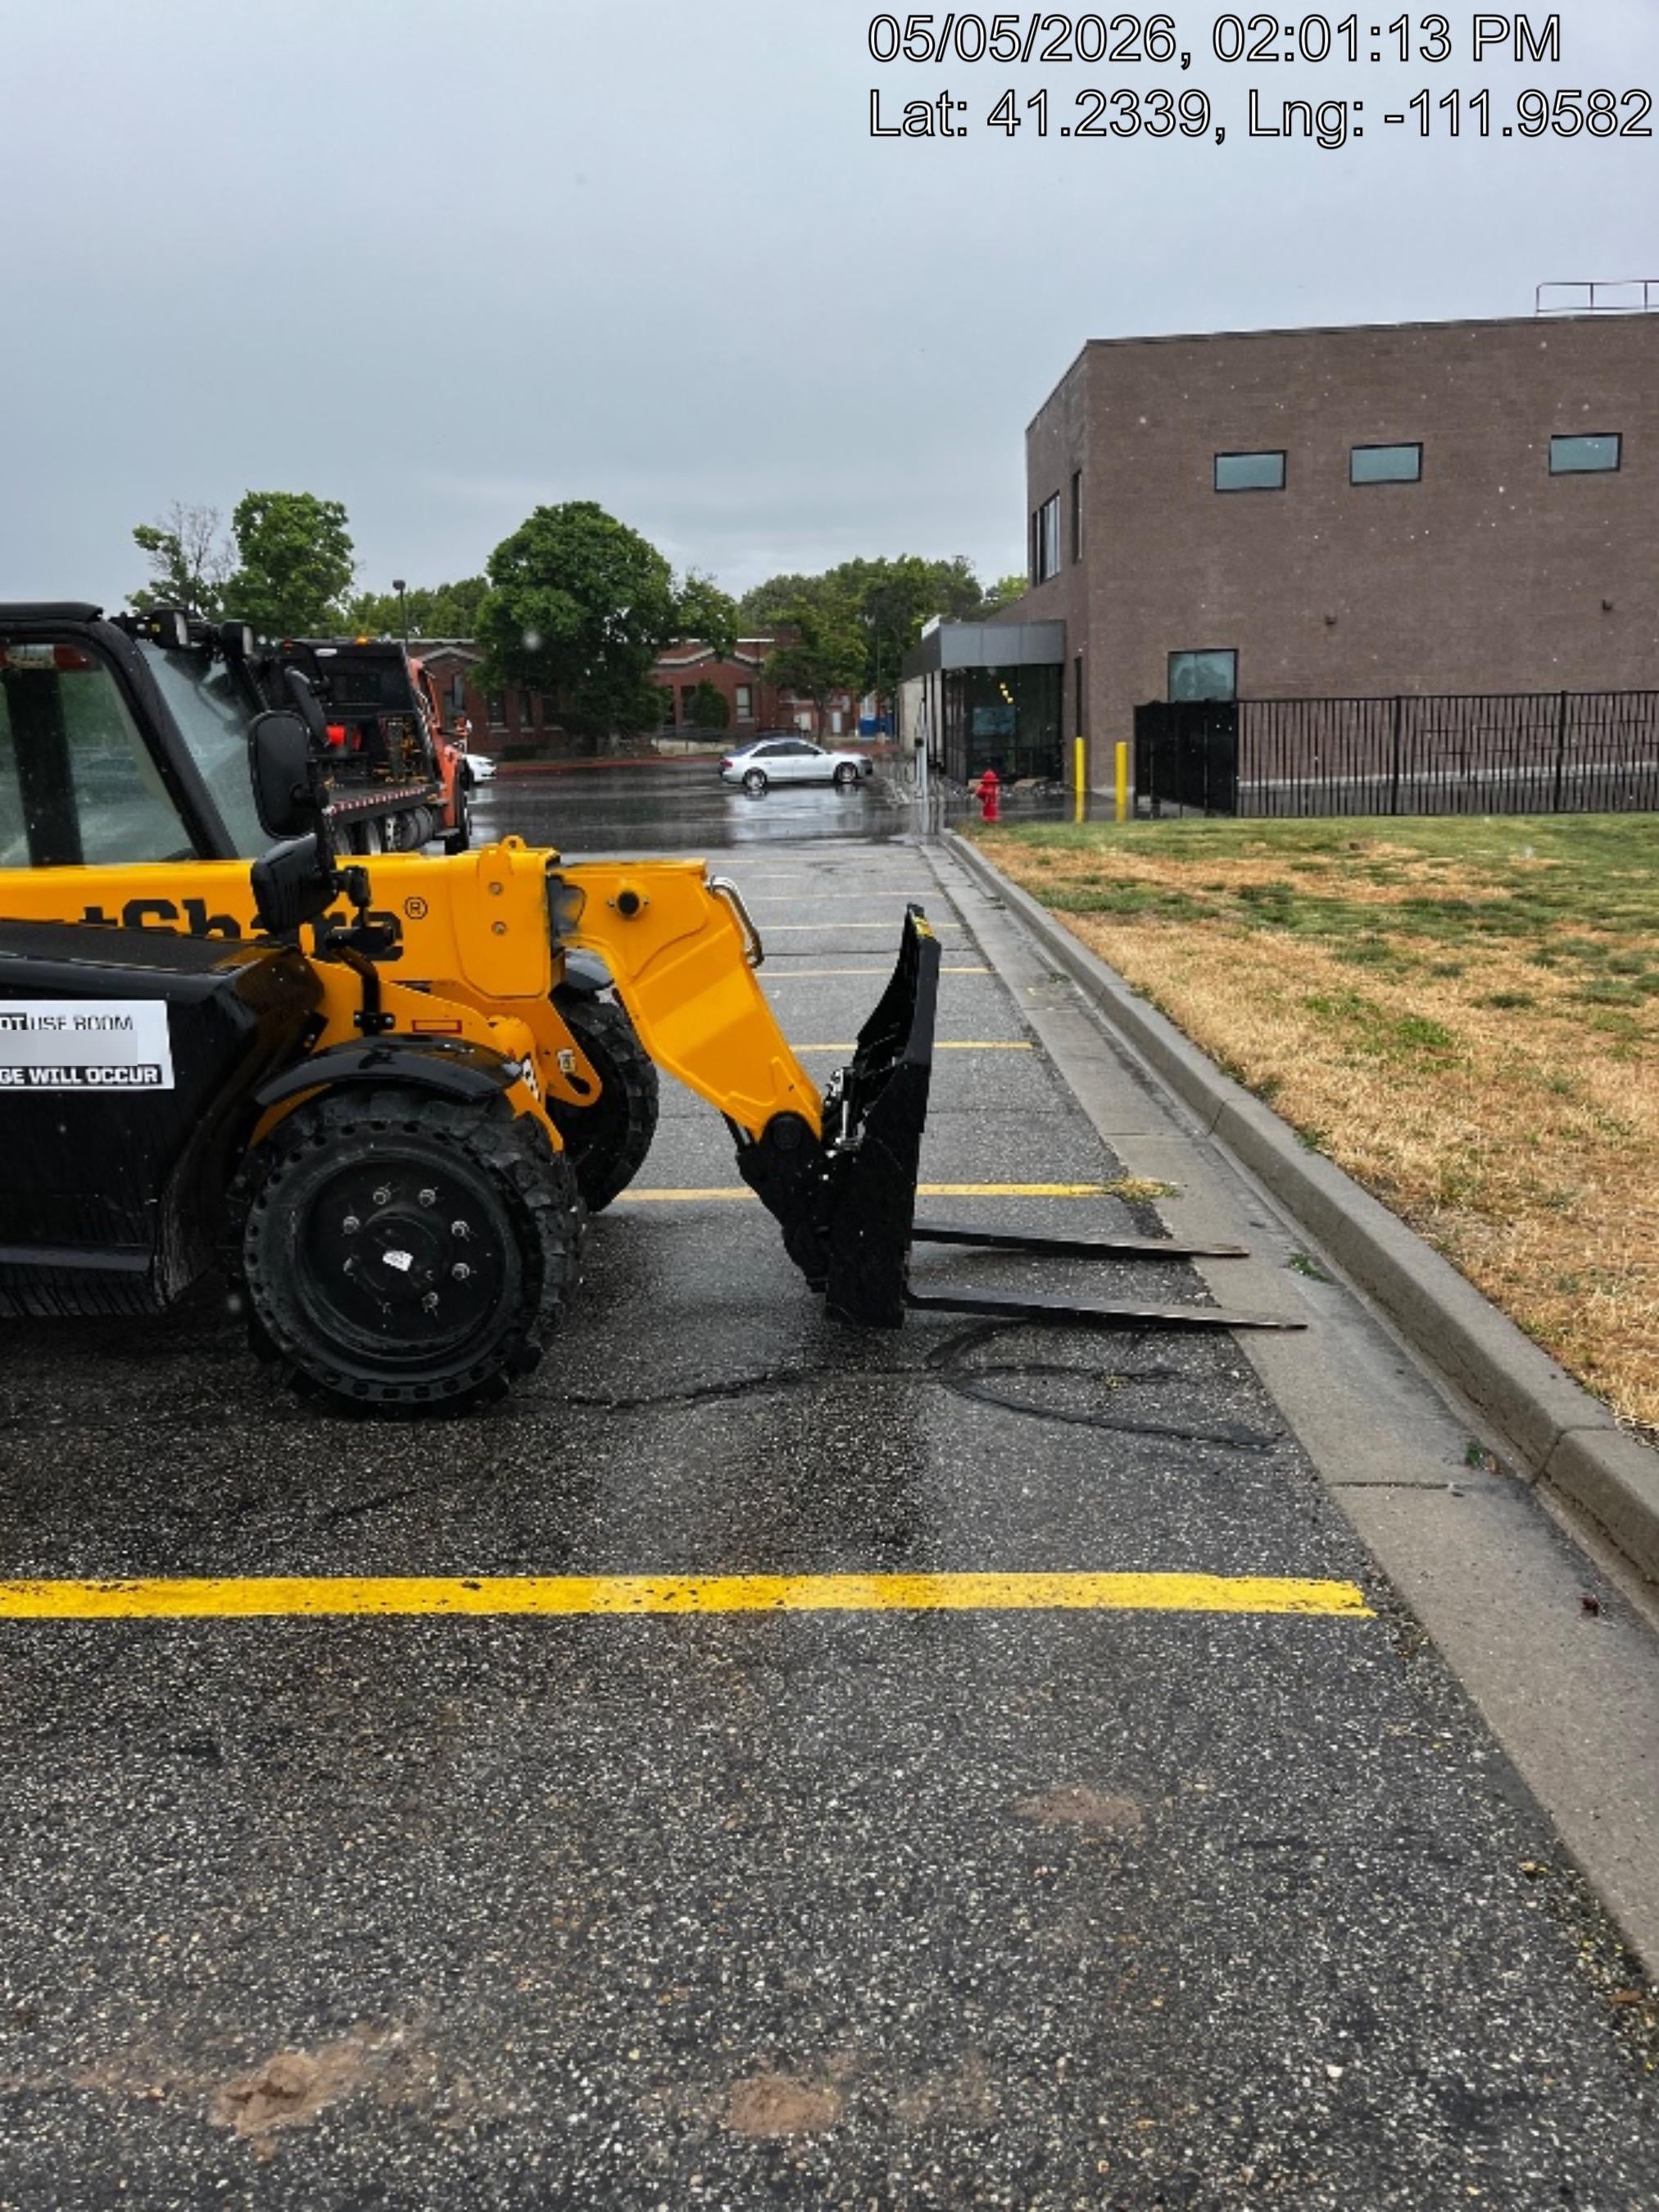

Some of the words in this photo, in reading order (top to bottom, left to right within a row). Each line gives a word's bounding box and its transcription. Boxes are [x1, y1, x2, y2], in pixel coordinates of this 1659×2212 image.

[30, 1015, 66, 1030] USE
[29, 1067, 82, 1084] WILL
[85, 1067, 157, 1083] OCCUR
